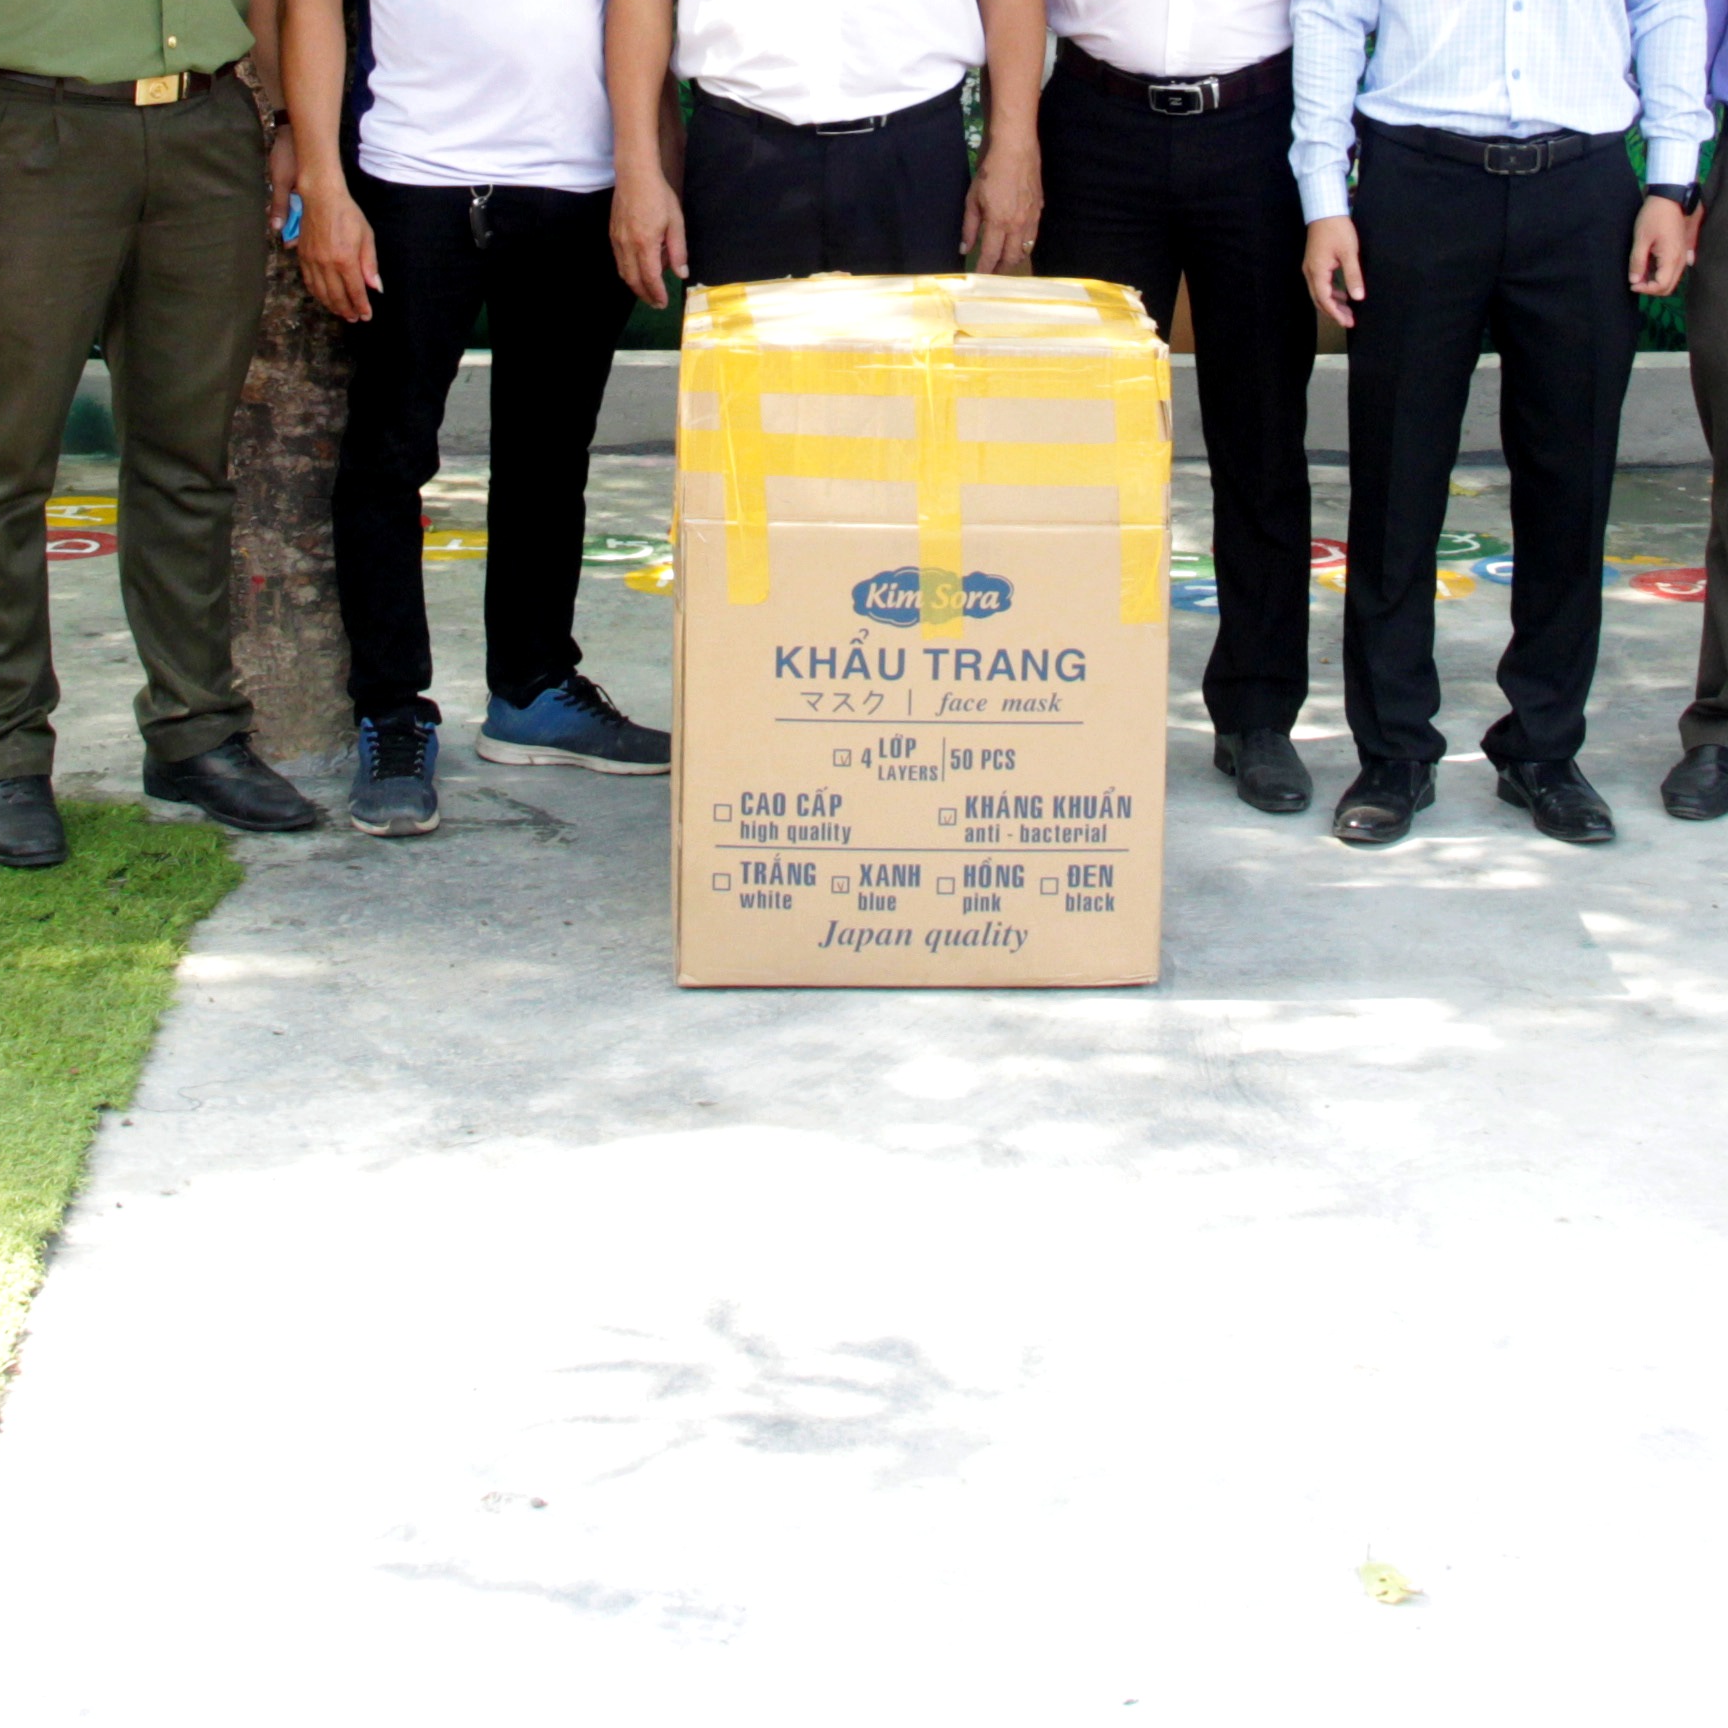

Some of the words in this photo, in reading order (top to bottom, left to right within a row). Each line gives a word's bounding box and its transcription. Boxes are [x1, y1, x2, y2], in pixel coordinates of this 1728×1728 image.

[865, 581, 922, 609] Kim
[934, 581, 1001, 610] Sora
[774, 628, 906, 682] KHẨU
[923, 648, 1087, 683] TRANG
[800, 690, 886, 716] マスク
[935, 692, 988, 717] face
[1001, 692, 1062, 713] mask
[861, 749, 872, 770] 4
[878, 735, 917, 759] LỚP
[950, 749, 973, 770] 50
[981, 749, 1016, 771] PCS
[878, 764, 938, 782] LAYERS
[740, 792, 786, 817] CAO
[796, 786, 843, 818] CẤP
[965, 790, 1044, 821] KHÁNG
[1053, 786, 1132, 821] KHUẨN
[740, 821, 779, 846] high
[787, 821, 851, 845] quality
[965, 824, 1000, 844] anti
[1020, 824, 1107, 845] bacterial
[740, 854, 816, 887] TRẮNG
[859, 864, 921, 888] XANH
[963, 857, 1025, 889] HỒNG
[1067, 864, 1114, 889] ĐEN
[740, 891, 792, 912] white
[858, 891, 897, 912] blue
[962, 892, 1002, 916] pink
[1065, 892, 1115, 913] black
[818, 920, 913, 953] Japan
[924, 922, 1028, 954] quality
